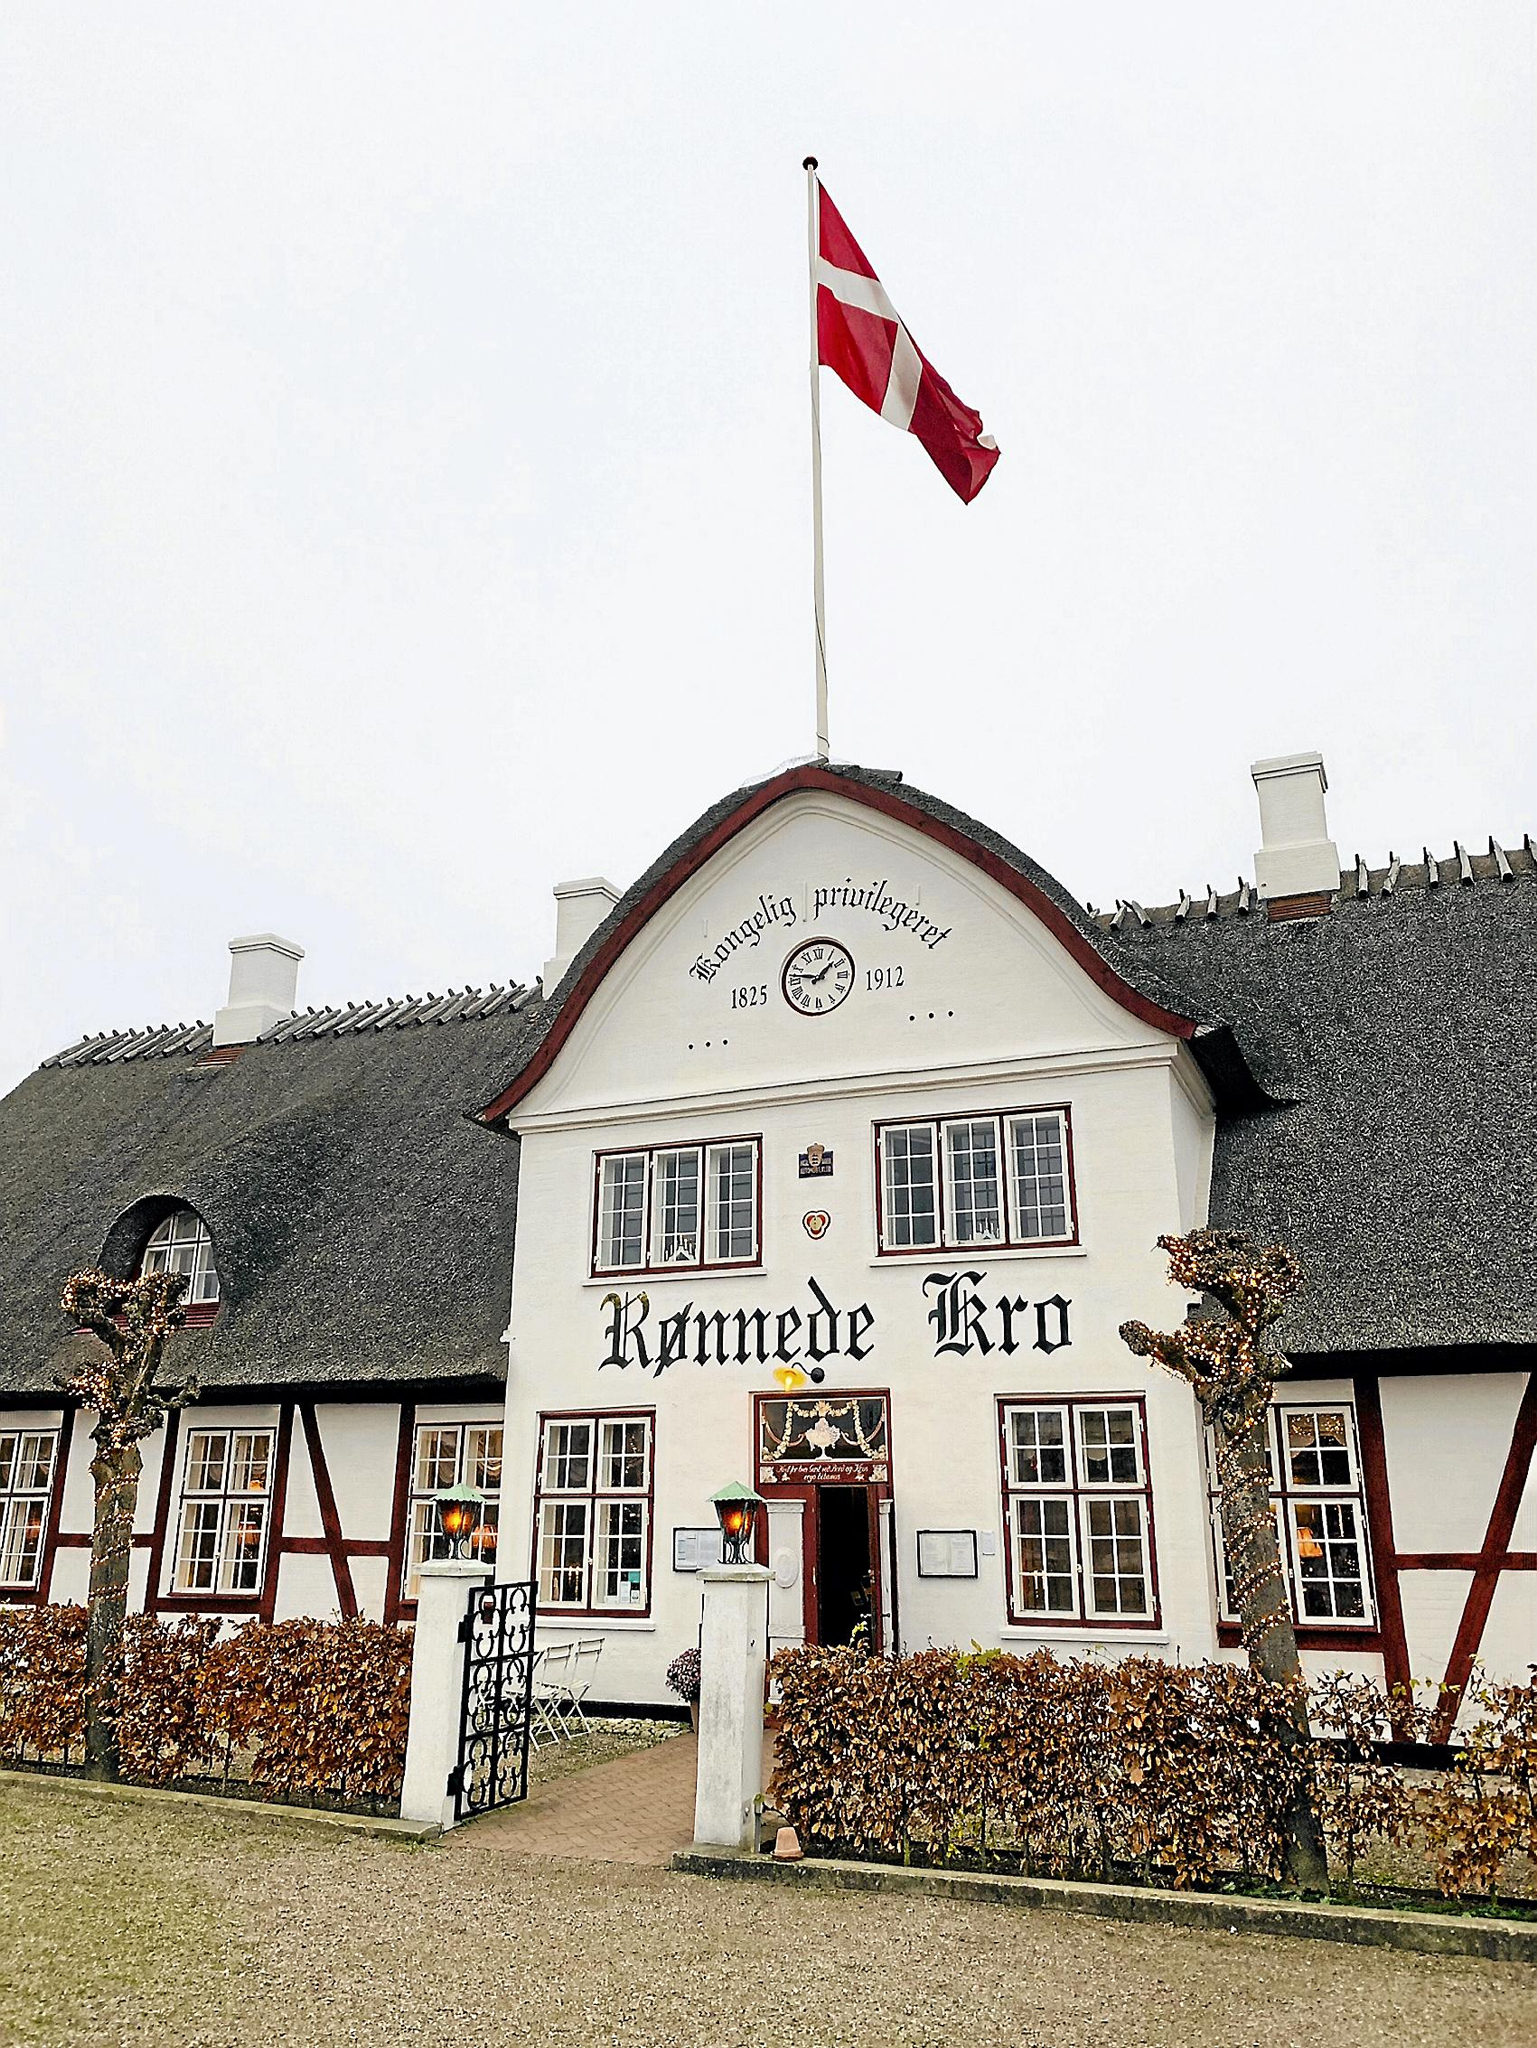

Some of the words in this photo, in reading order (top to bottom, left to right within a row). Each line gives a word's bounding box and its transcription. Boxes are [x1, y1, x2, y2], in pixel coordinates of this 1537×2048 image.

[689, 895, 797, 984] Kongelig
[813, 877, 953, 949] privilegeret
[731, 985, 768, 1009] 1825
[866, 965, 905, 991] 1912
[598, 1276, 875, 1378] Rønnede
[922, 1270, 1073, 1357] Kro
